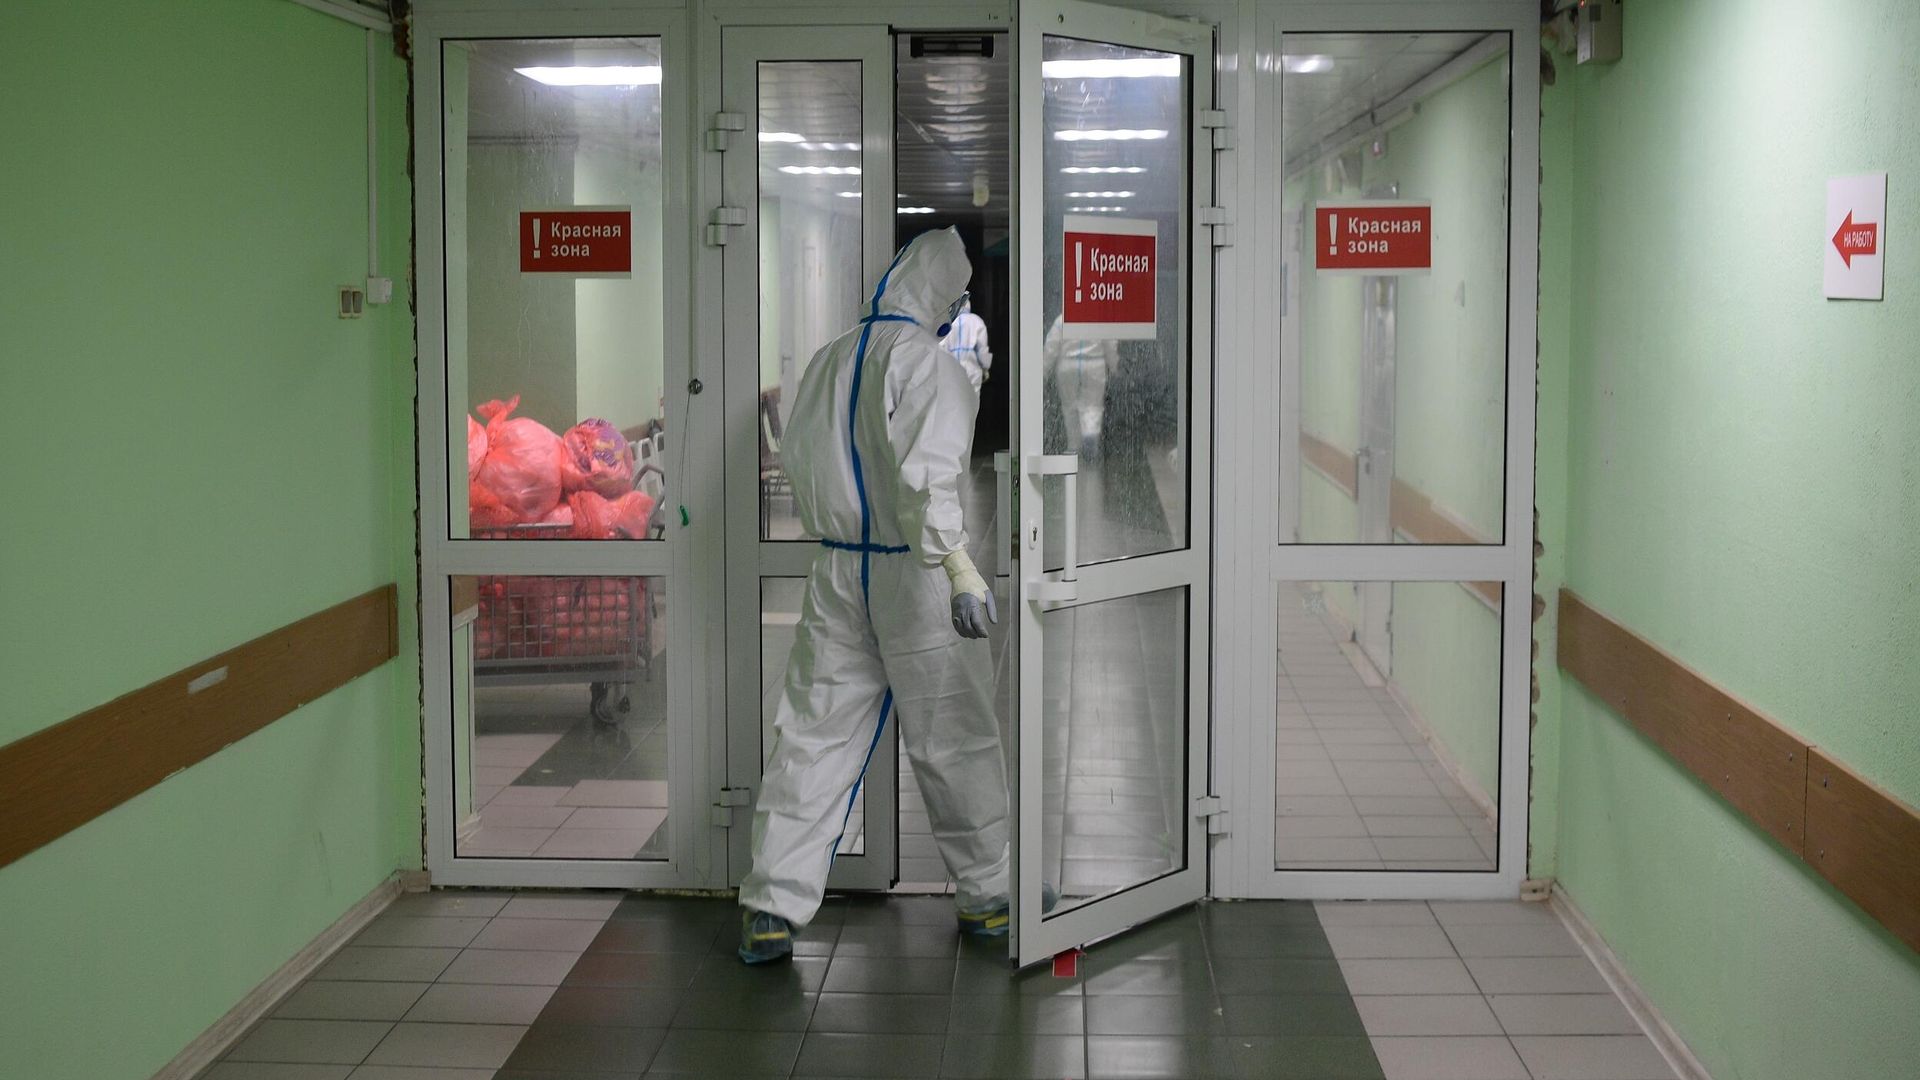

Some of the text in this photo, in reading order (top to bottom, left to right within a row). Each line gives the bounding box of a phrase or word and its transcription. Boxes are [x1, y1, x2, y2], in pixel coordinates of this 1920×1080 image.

[551, 221, 621, 241] Красная
[1348, 216, 1421, 237] Красная
[1348, 240, 1389, 253] зона
[1843, 230, 1874, 248] НА РАБОТУ
[551, 244, 590, 257] зона
[1090, 247, 1149, 278] Красная
[1090, 282, 1123, 301] зона
